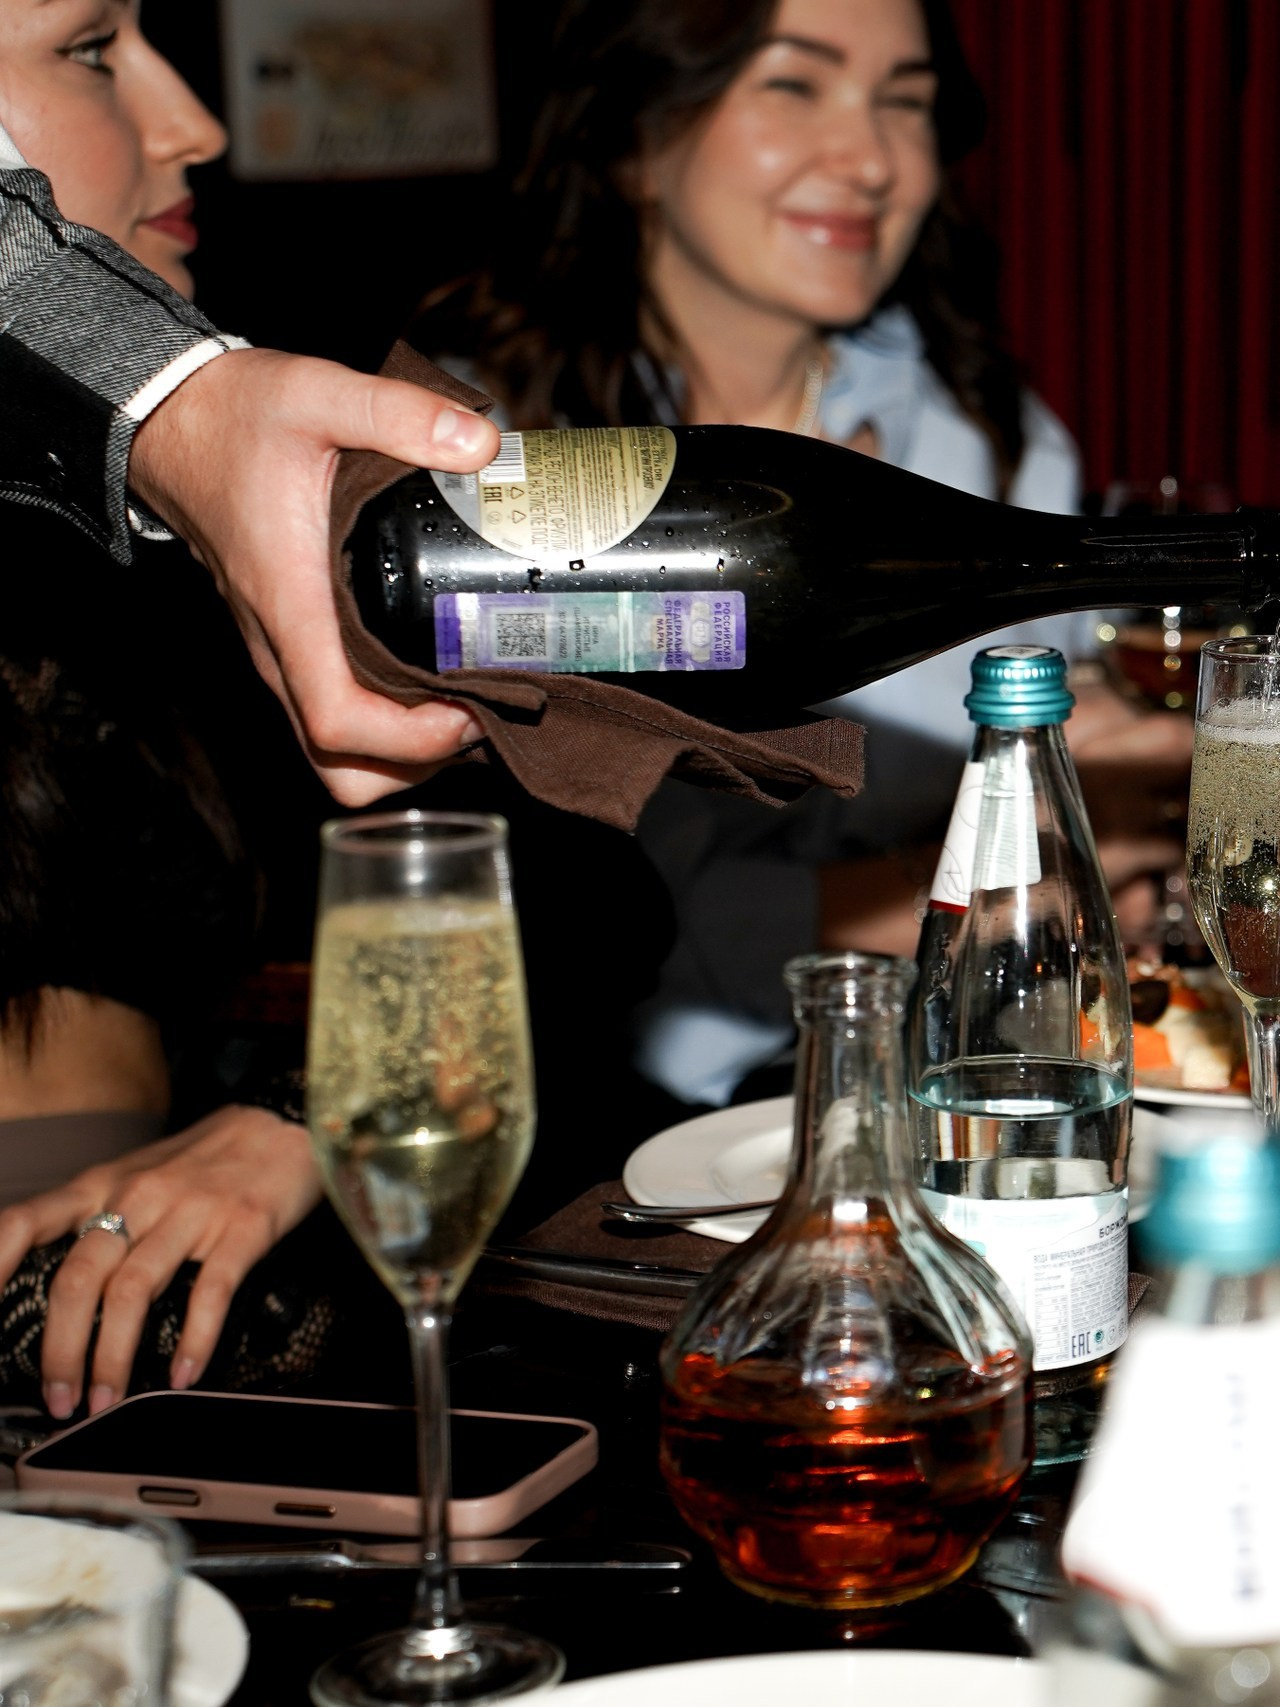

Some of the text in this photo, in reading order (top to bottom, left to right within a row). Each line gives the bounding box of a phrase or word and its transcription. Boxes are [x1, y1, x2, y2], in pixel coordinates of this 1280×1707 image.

[528, 480, 545, 490] НА
[654, 468, 663, 482] DRY
[529, 490, 546, 526] ЭТИКЕТКЕ
[583, 616, 591, 653] ИГРИСТЫЕ
[656, 618, 665, 650] МАРКА
[664, 600, 674, 664] СПЕЦИАЛЬНАЯ
[673, 600, 682, 664] ФЕДЕРАЛЬНАЯ
[714, 602, 723, 663] ФЕДЕРАЦИЯ
[722, 601, 732, 664] РОССИЙСКАЯ
[1071, 1332, 1092, 1359] EAC
